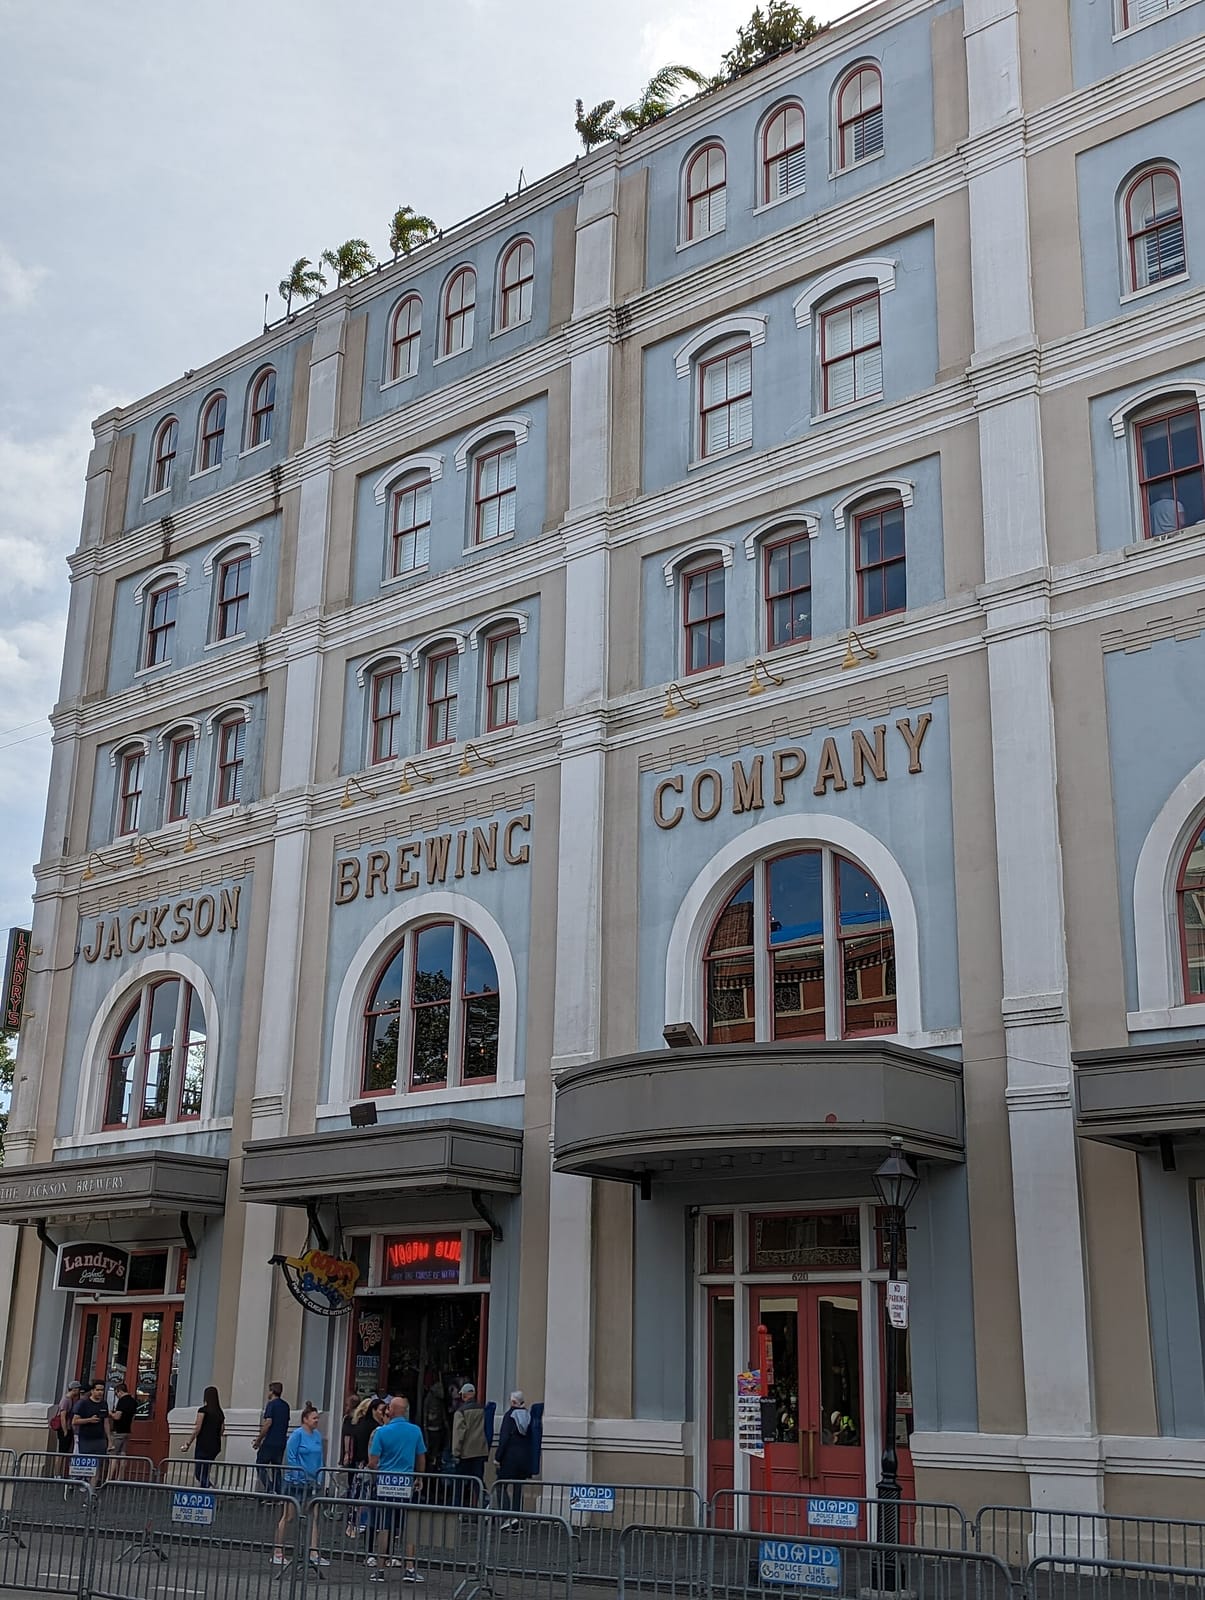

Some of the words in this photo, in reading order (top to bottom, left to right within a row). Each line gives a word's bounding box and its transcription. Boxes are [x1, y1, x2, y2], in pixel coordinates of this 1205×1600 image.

[653, 712, 932, 830] COMPANY
[335, 813, 531, 905] BREWING
[82, 885, 242, 963] JACKSON
[0, 1187, 18, 1199] THE
[26, 1182, 67, 1197] JACKSON
[76, 1176, 123, 1193] BREWERY
[63, 1251, 126, 1277] Landry's
[791, 1271, 809, 1282] 620
[894, 1284, 901, 1292] NO
[888, 1294, 906, 1304] PARKING
[816, 1512, 834, 1520] POLICE
[774, 1562, 802, 1573] POLICE
[808, 1566, 825, 1576] LINE
[785, 1572, 801, 1581] NOT
[805, 1574, 831, 1585] CROSS
